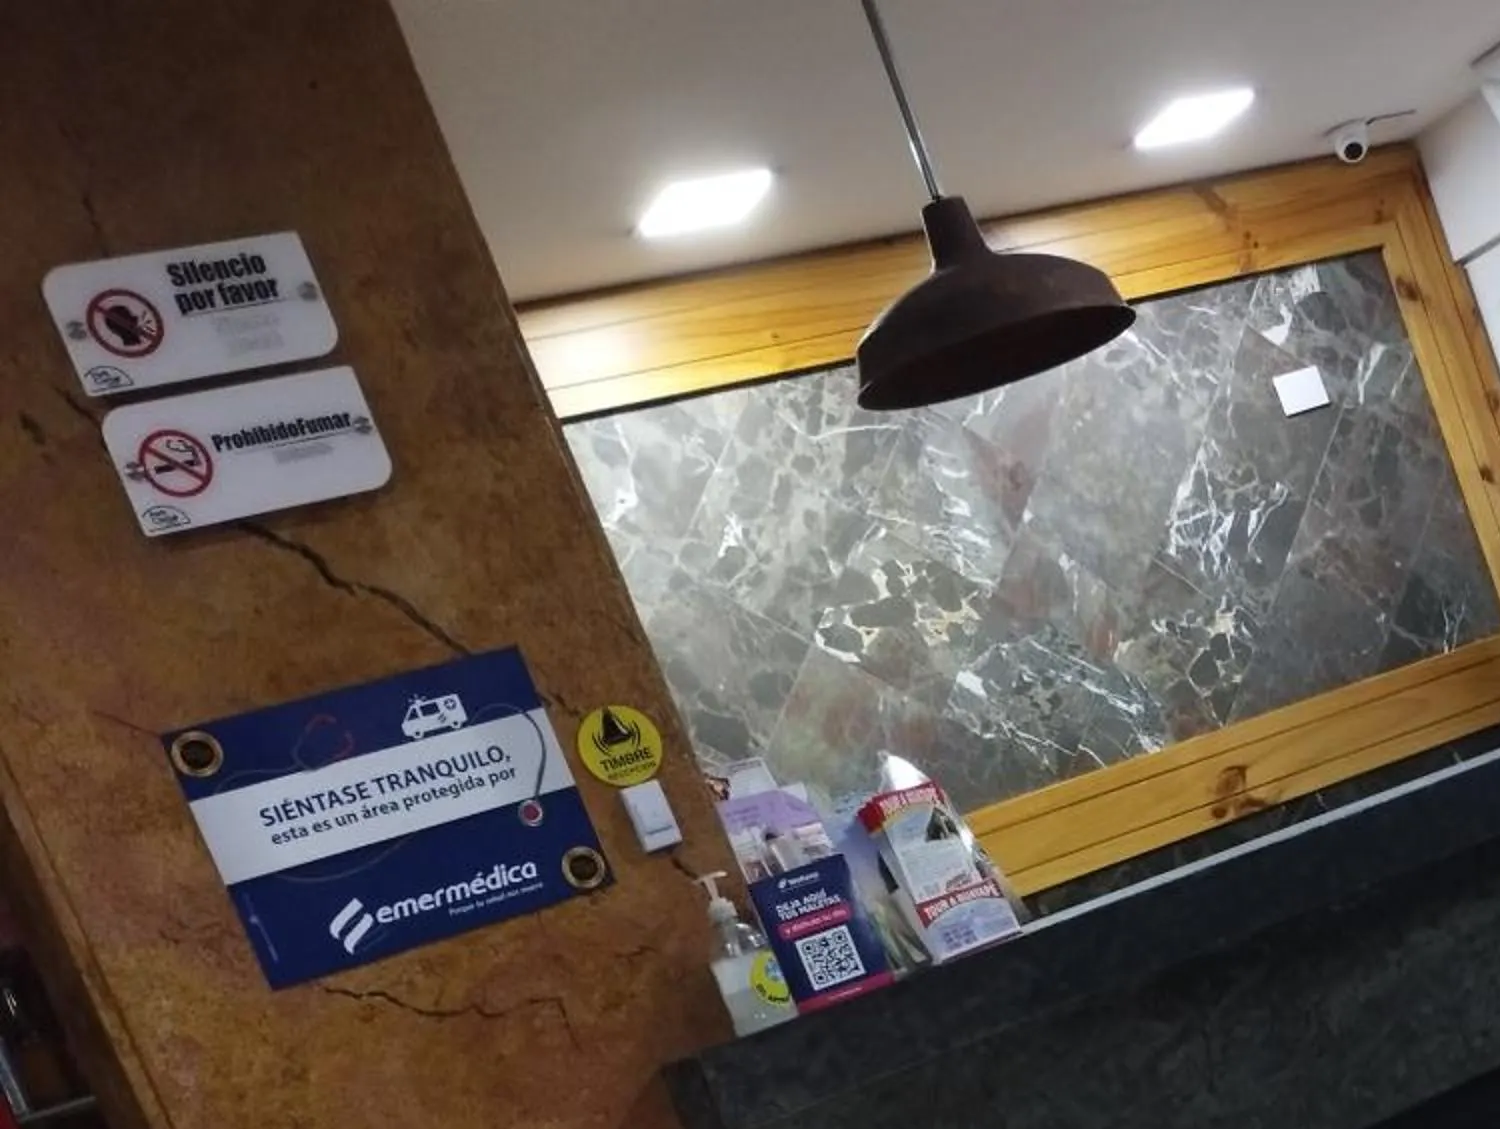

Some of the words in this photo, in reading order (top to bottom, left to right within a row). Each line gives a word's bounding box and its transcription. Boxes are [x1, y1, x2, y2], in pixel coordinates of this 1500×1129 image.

[166, 253, 267, 288] Silencio
[174, 289, 216, 316] por
[217, 278, 279, 306] favor
[599, 746, 654, 772] TIMBRE
[259, 781, 372, 827] SIÉNTASE
[371, 745, 512, 796] TRANQUILO,
[271, 827, 309, 845] esta
[312, 819, 332, 833] es
[335, 812, 359, 827] un
[361, 801, 400, 820] área
[403, 774, 485, 812] protegida
[488, 767, 515, 789] por
[376, 861, 537, 924] emermédica
